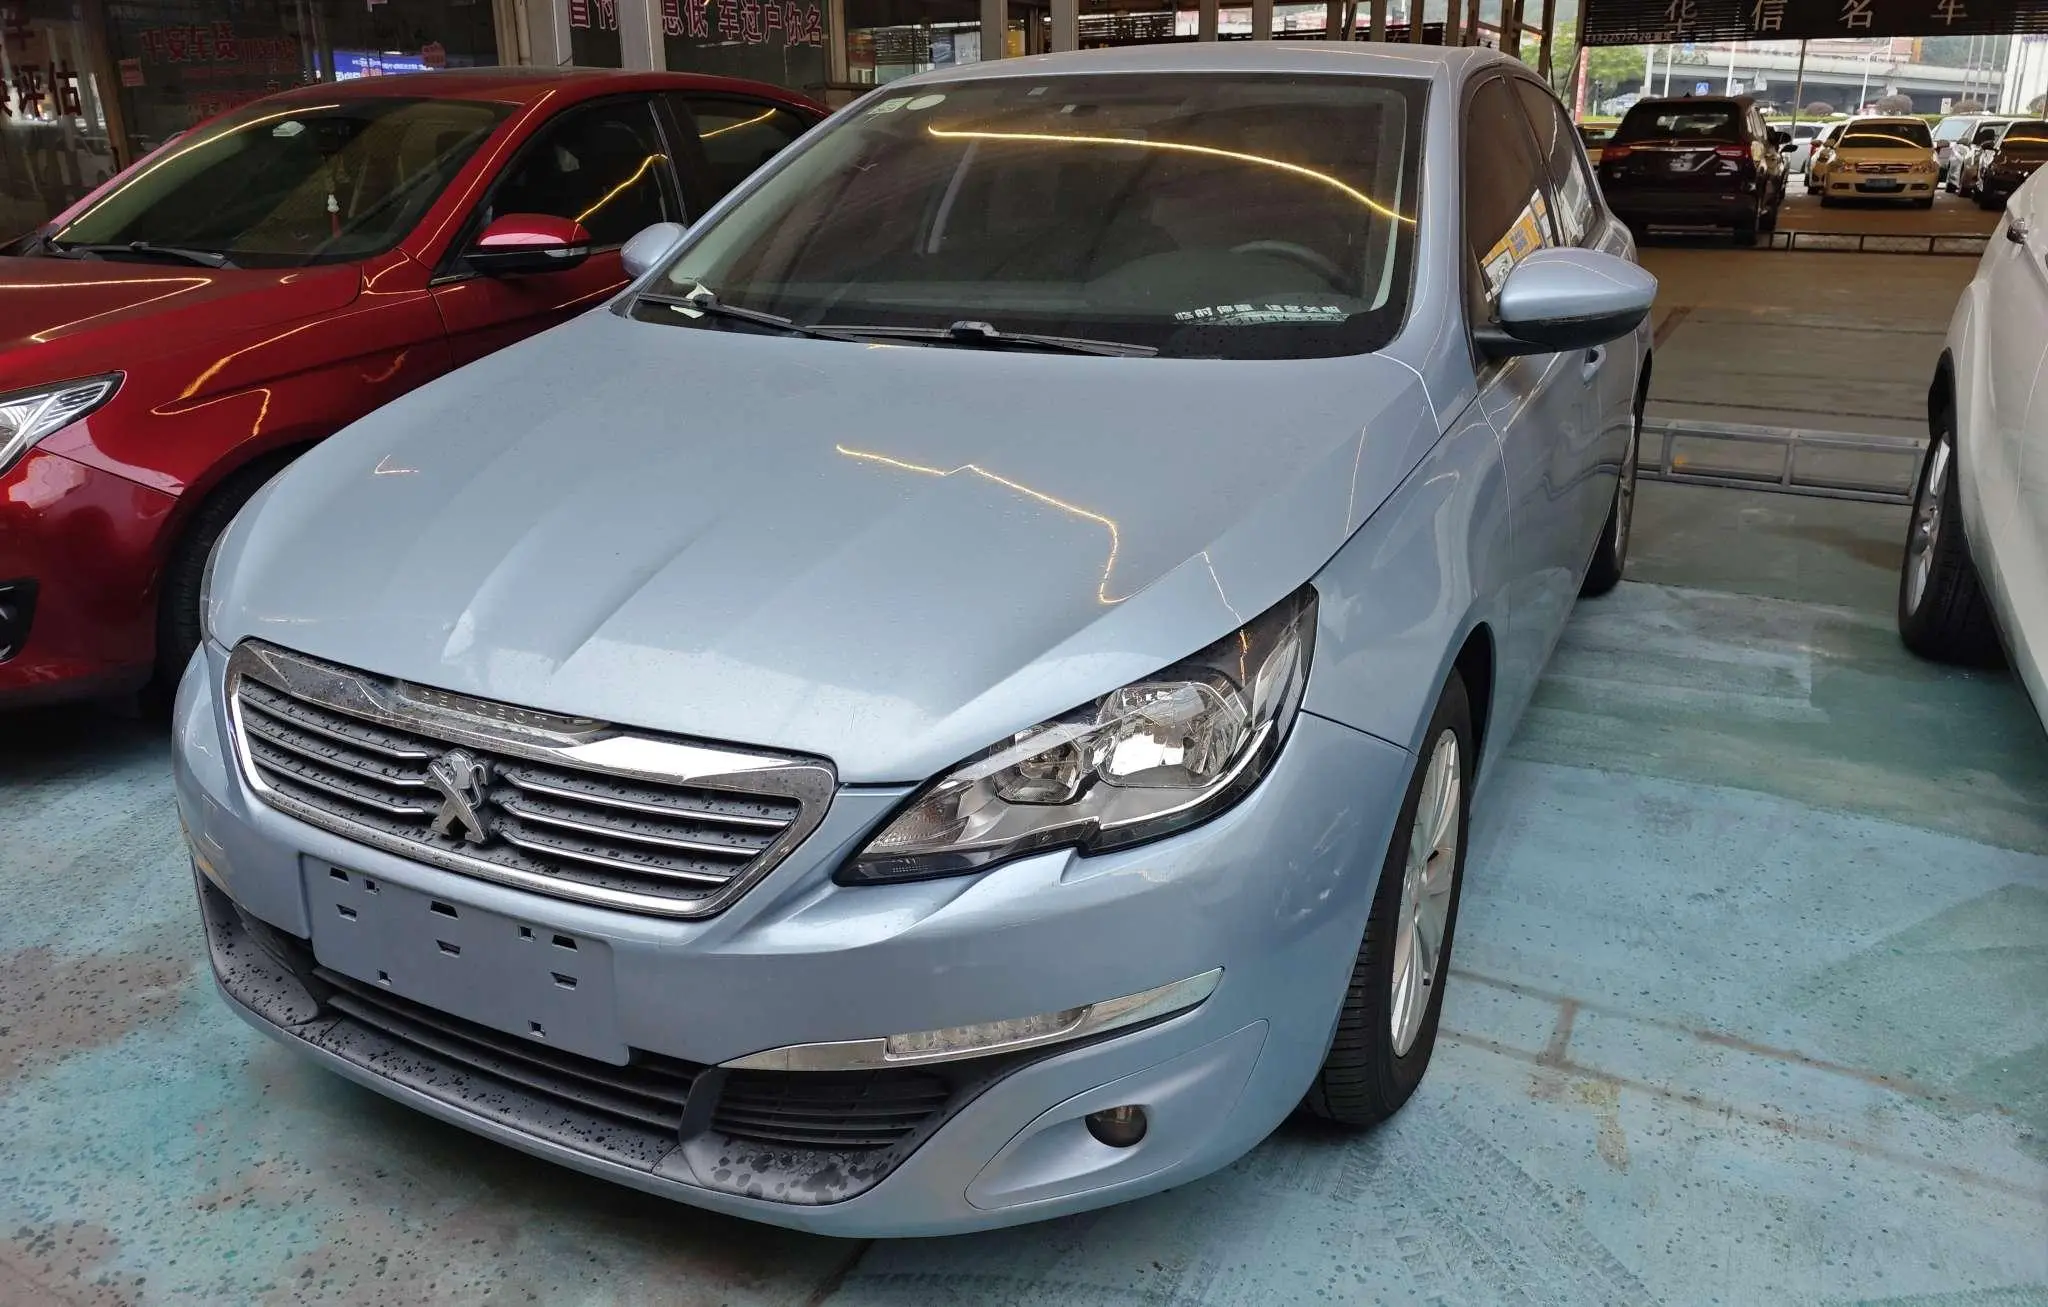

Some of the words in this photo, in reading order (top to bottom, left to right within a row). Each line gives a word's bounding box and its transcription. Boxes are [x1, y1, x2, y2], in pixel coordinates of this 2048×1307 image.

[718, 0, 823, 48] 车过户你名
[1664, 0, 1968, 34] 华信名车
[421, 689, 548, 728] PEUGEOT
